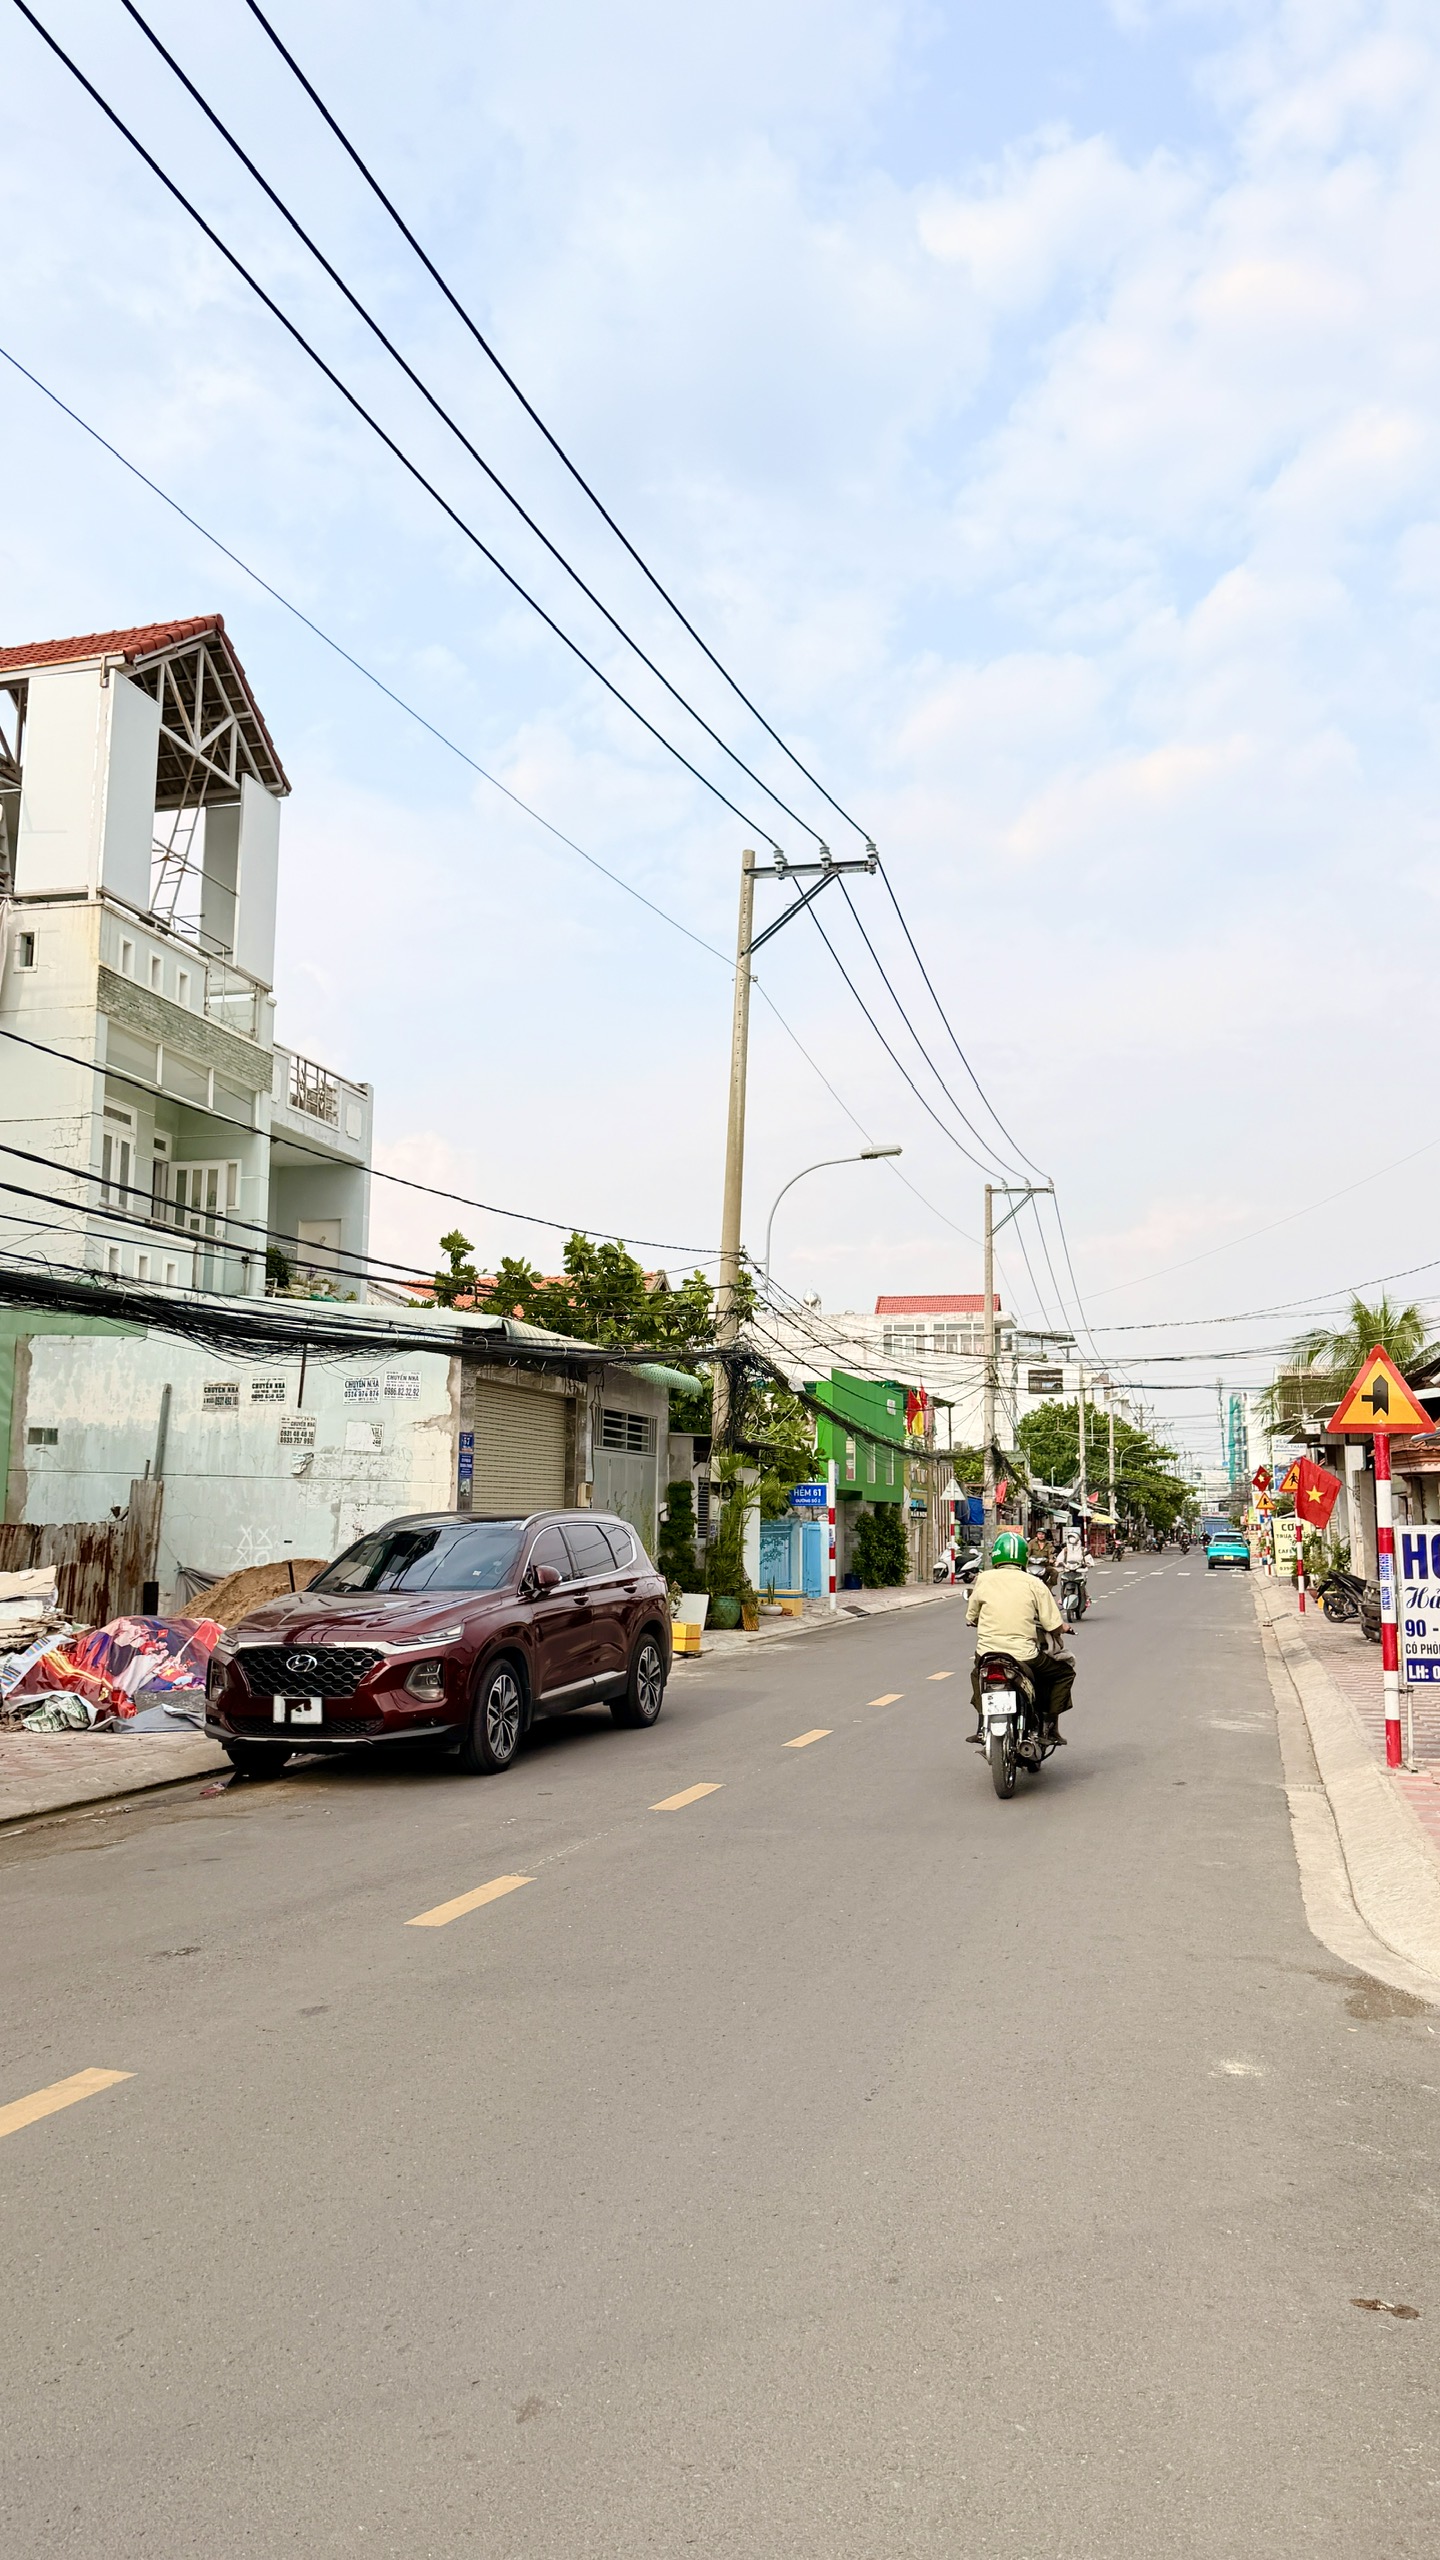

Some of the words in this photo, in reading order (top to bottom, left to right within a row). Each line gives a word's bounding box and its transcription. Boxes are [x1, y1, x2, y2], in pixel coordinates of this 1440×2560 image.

[813, 1488, 821, 1497] 61
[1405, 1619, 1426, 1637] 90
[1405, 1641, 1417, 1655] CÓ
[1420, 1640, 1440, 1655] PHÒ
[1408, 1665, 1429, 1680] LH:
